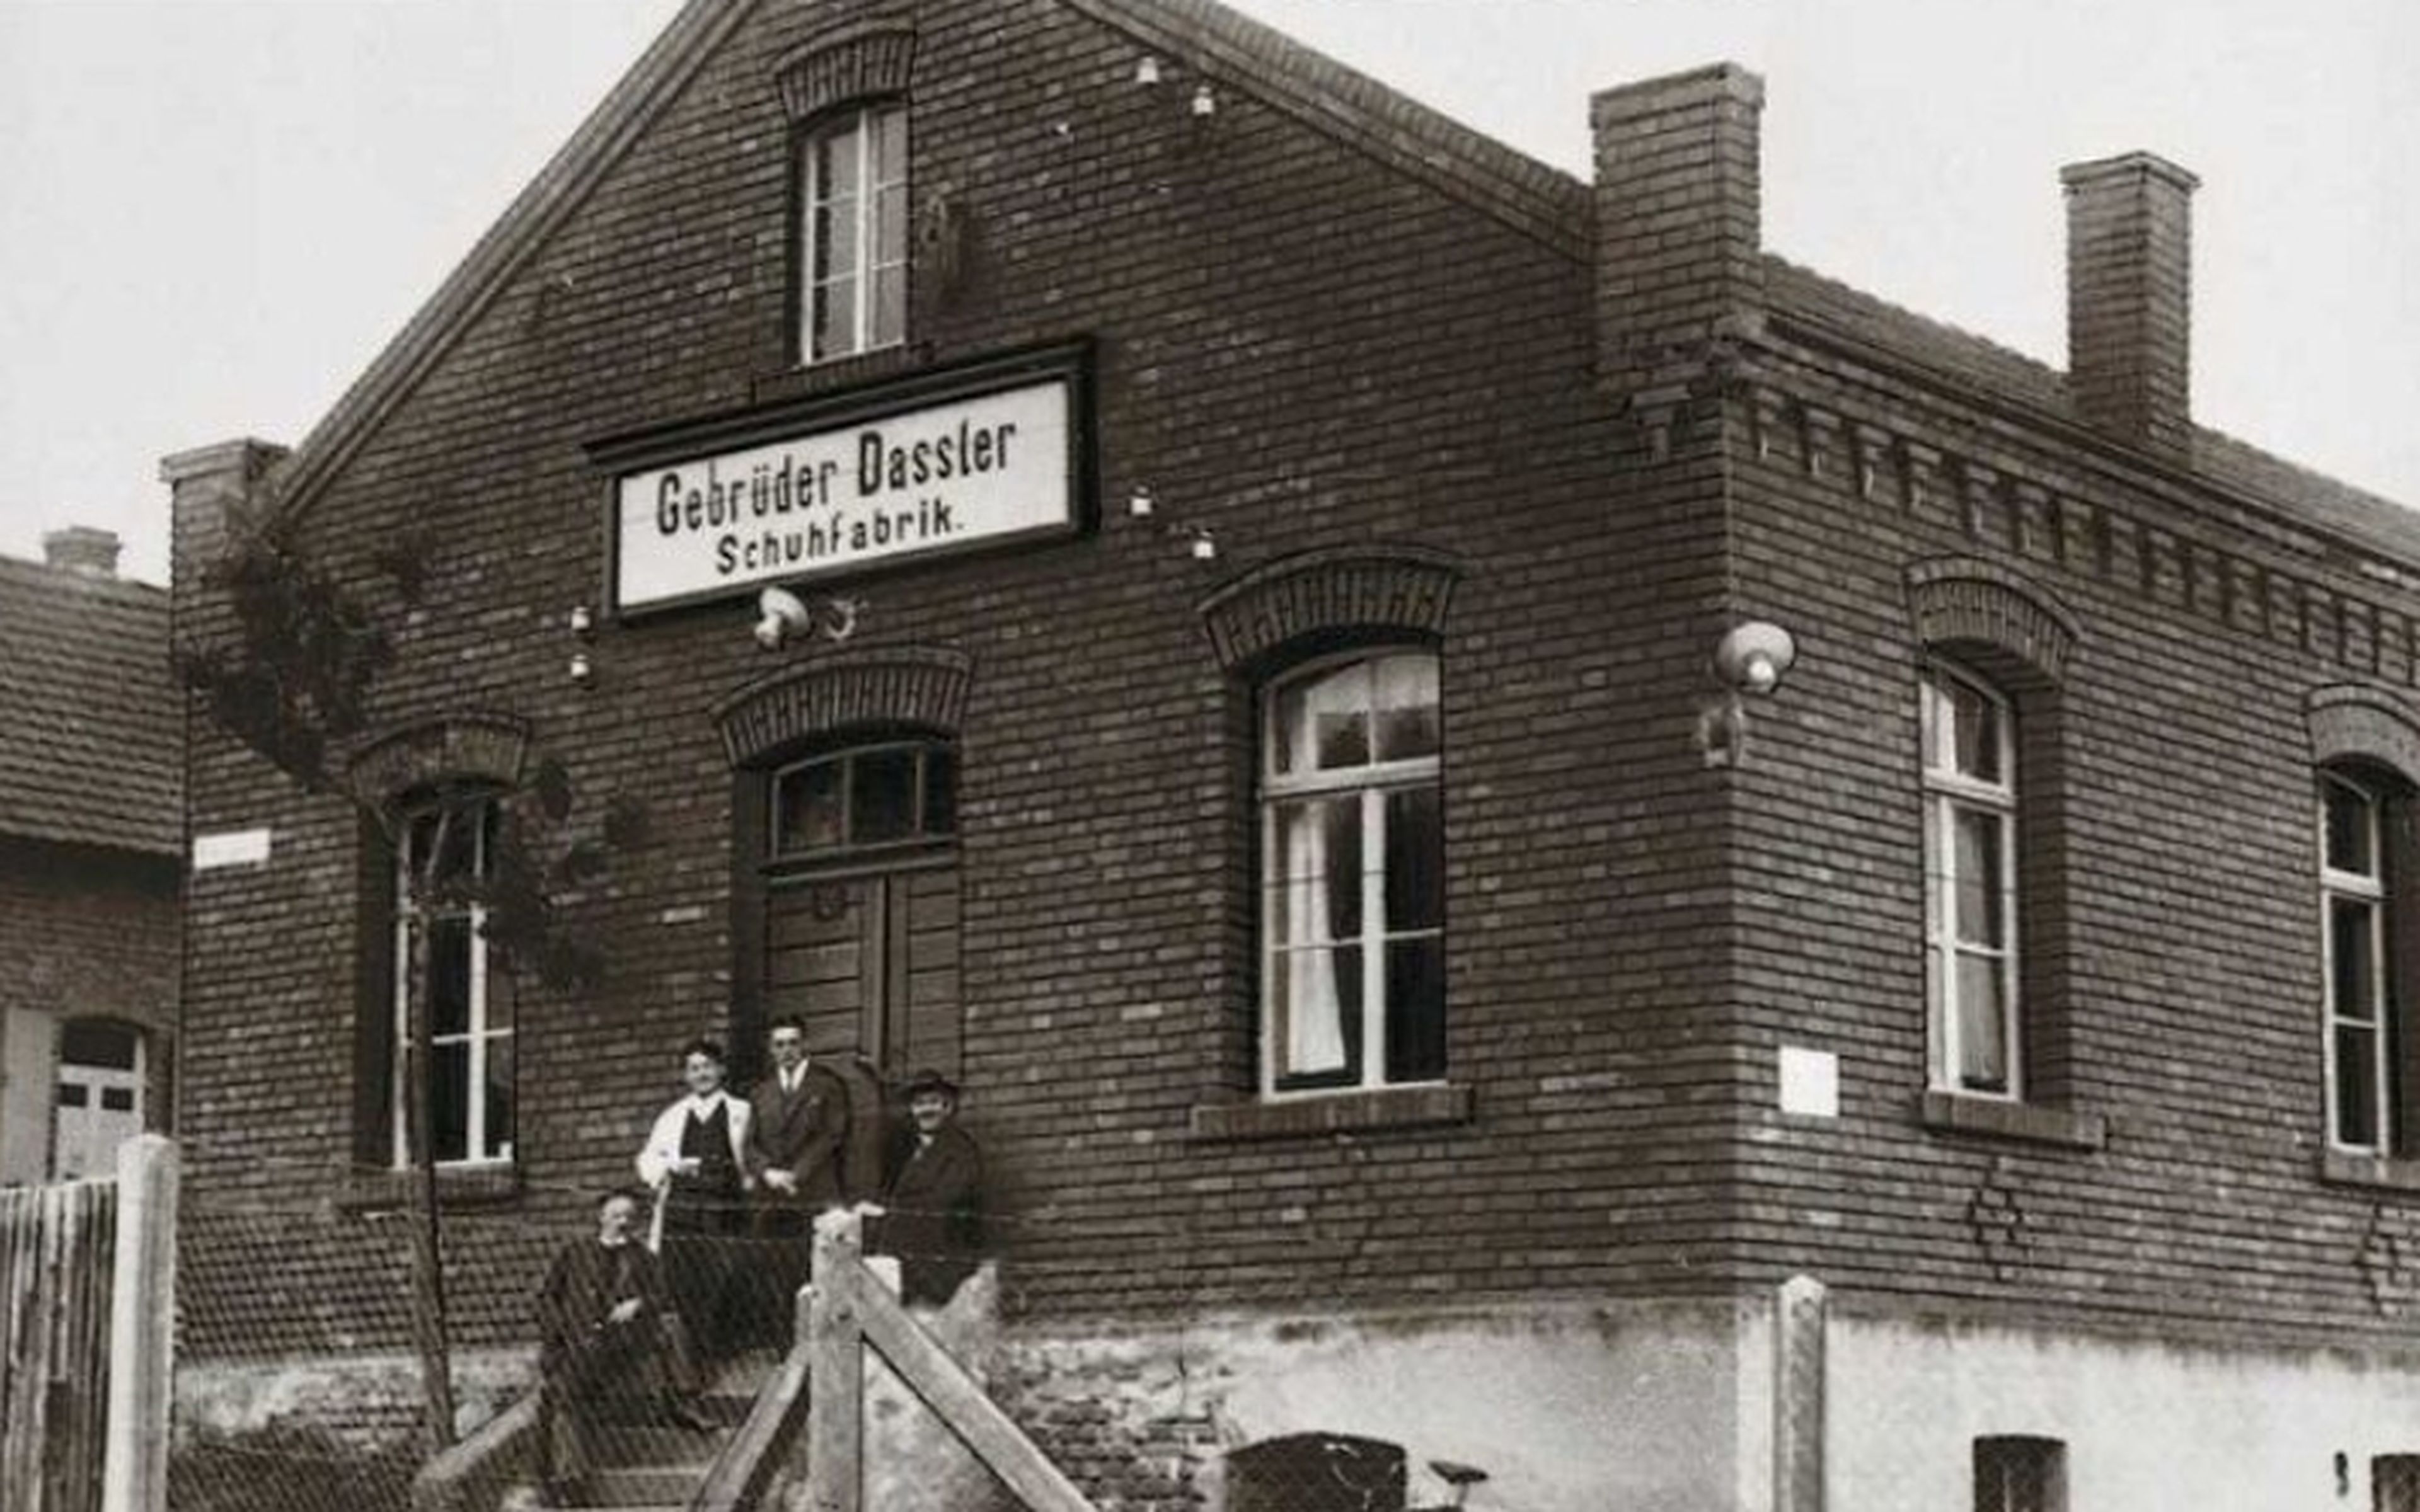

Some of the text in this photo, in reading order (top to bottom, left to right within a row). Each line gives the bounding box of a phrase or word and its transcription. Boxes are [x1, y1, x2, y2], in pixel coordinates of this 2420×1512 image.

[656, 420, 1015, 536] Gebrüder Dassler
[716, 498, 965, 575] Schuhfabrik.
